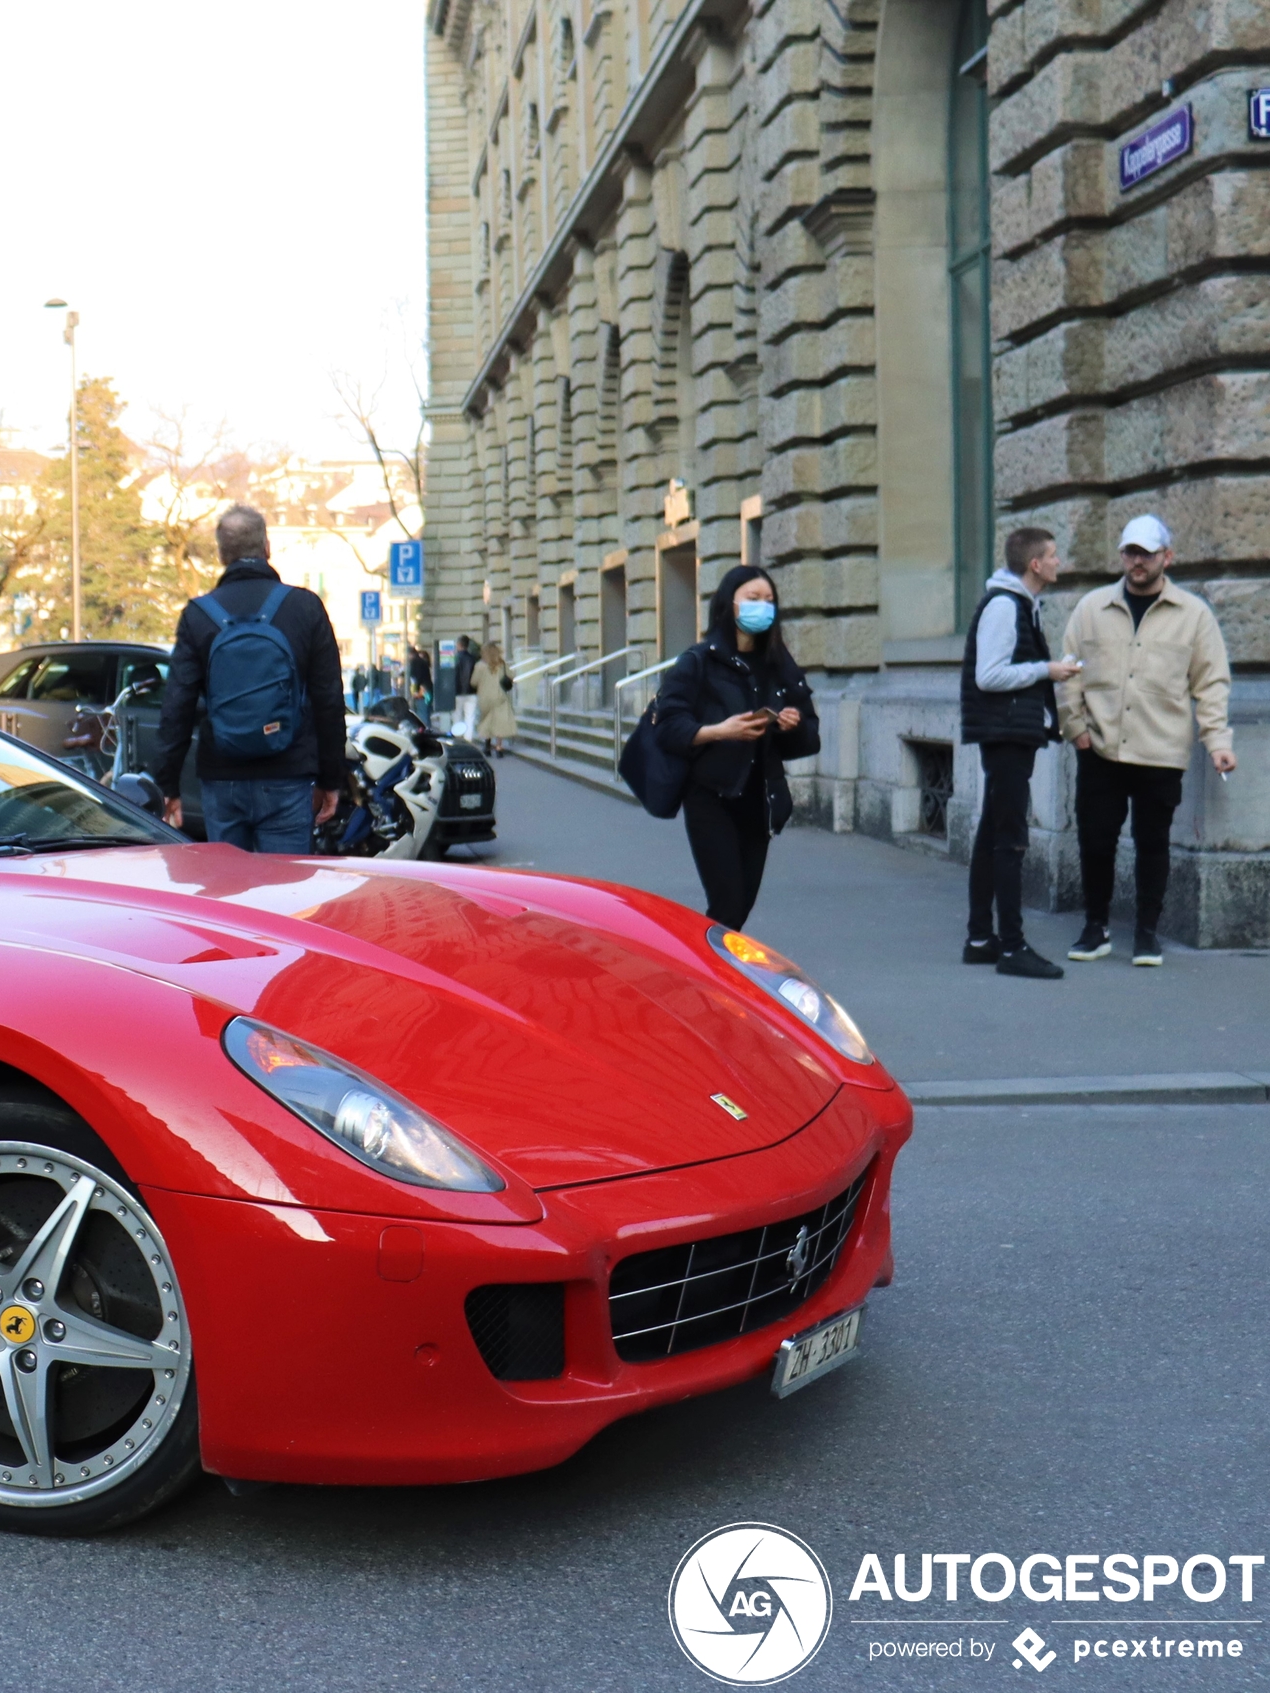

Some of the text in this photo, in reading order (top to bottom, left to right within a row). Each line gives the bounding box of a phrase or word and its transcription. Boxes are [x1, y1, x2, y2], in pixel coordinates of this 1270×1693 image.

[399, 545, 413, 566] P
[366, 593, 375, 608] P
[789, 1339, 813, 1380] ZH
